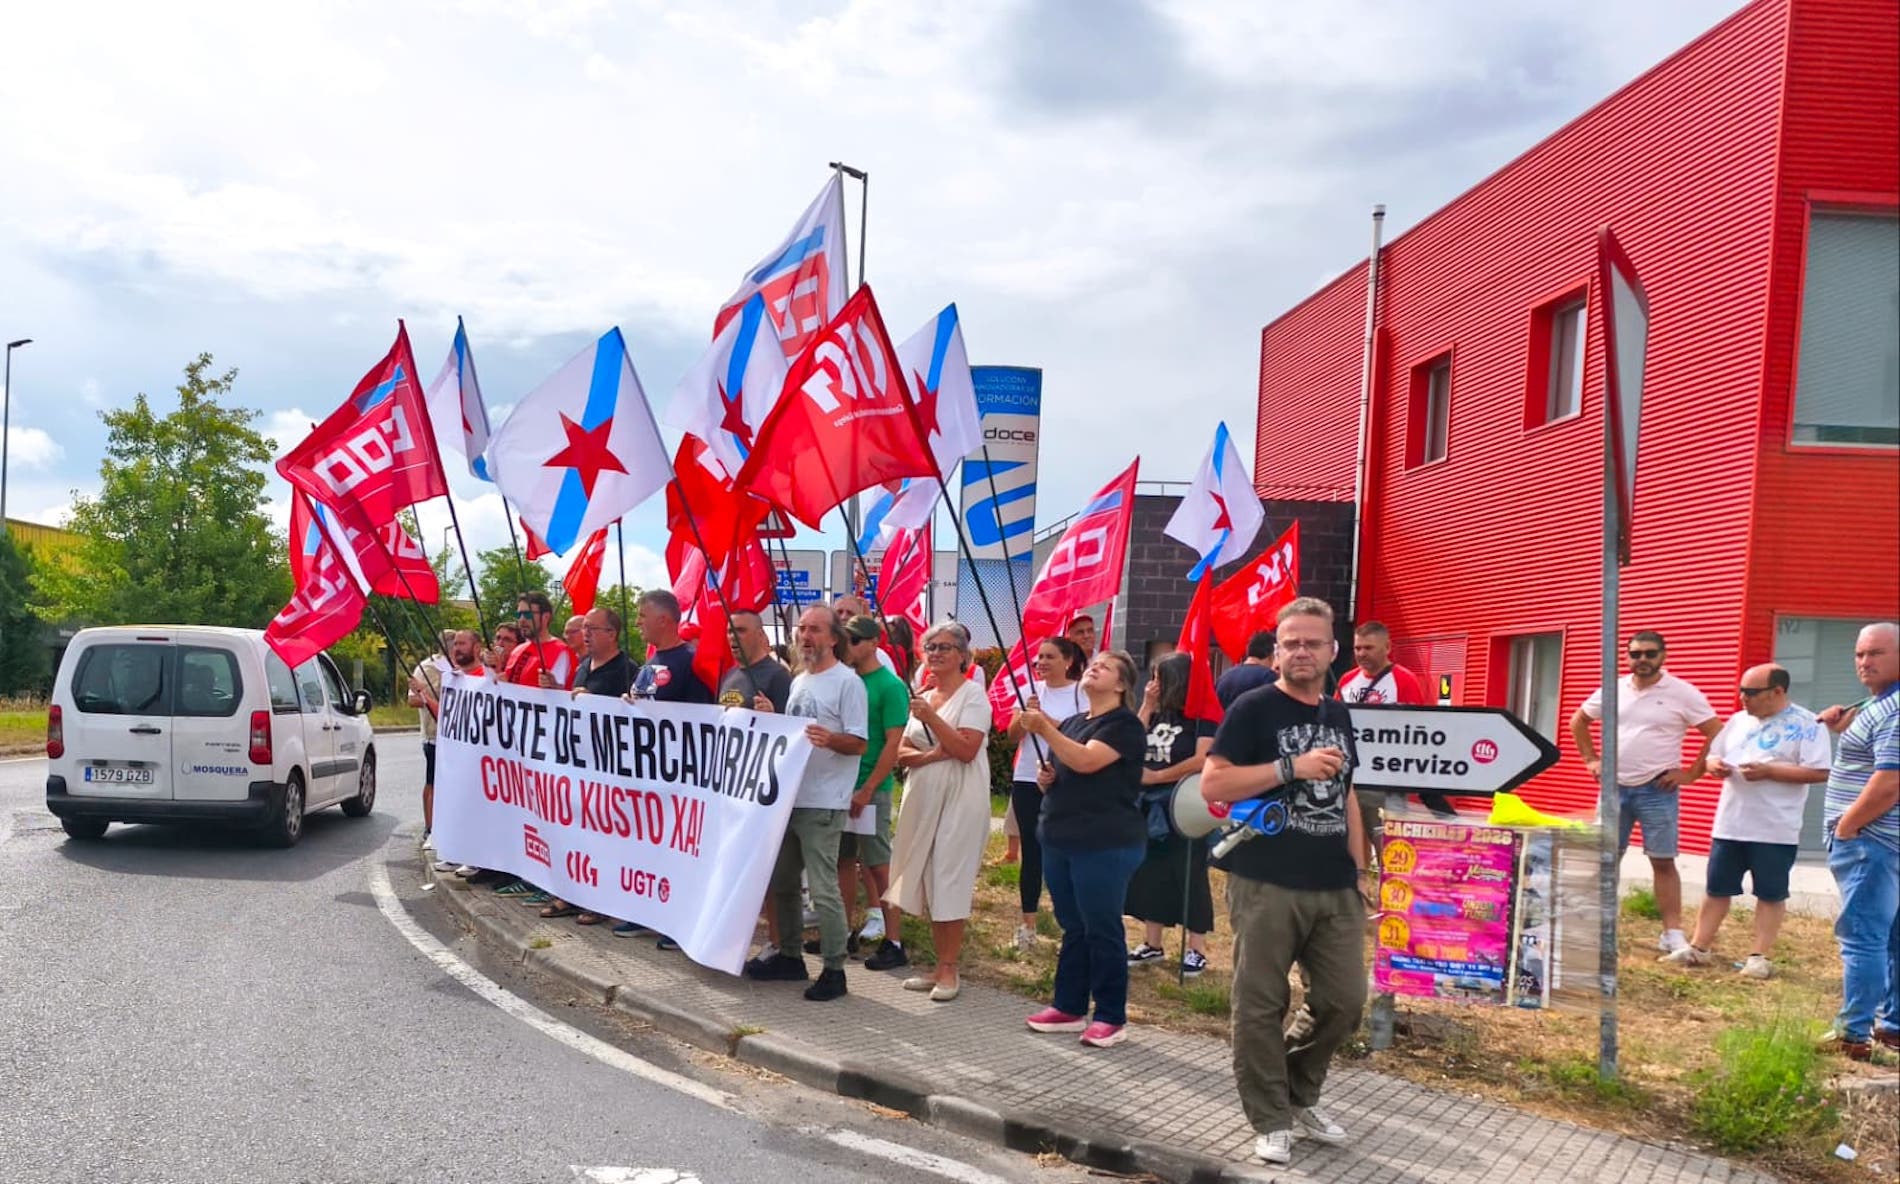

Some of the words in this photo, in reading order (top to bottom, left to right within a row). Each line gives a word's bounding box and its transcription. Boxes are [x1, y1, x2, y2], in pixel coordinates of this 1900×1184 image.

[977, 394, 1038, 407] ORMACION
[983, 427, 1036, 442] doce
[1351, 724, 1446, 746] camiño
[554, 706, 586, 768] DE
[590, 711, 788, 806] MERCADORÍAS
[1371, 754, 1469, 776] servizo
[94, 768, 123, 781] 1579
[127, 769, 151, 782] GZB
[193, 765, 248, 774] MOSQUERA
[669, 794, 705, 858] XA!
[620, 865, 656, 898] UGT
